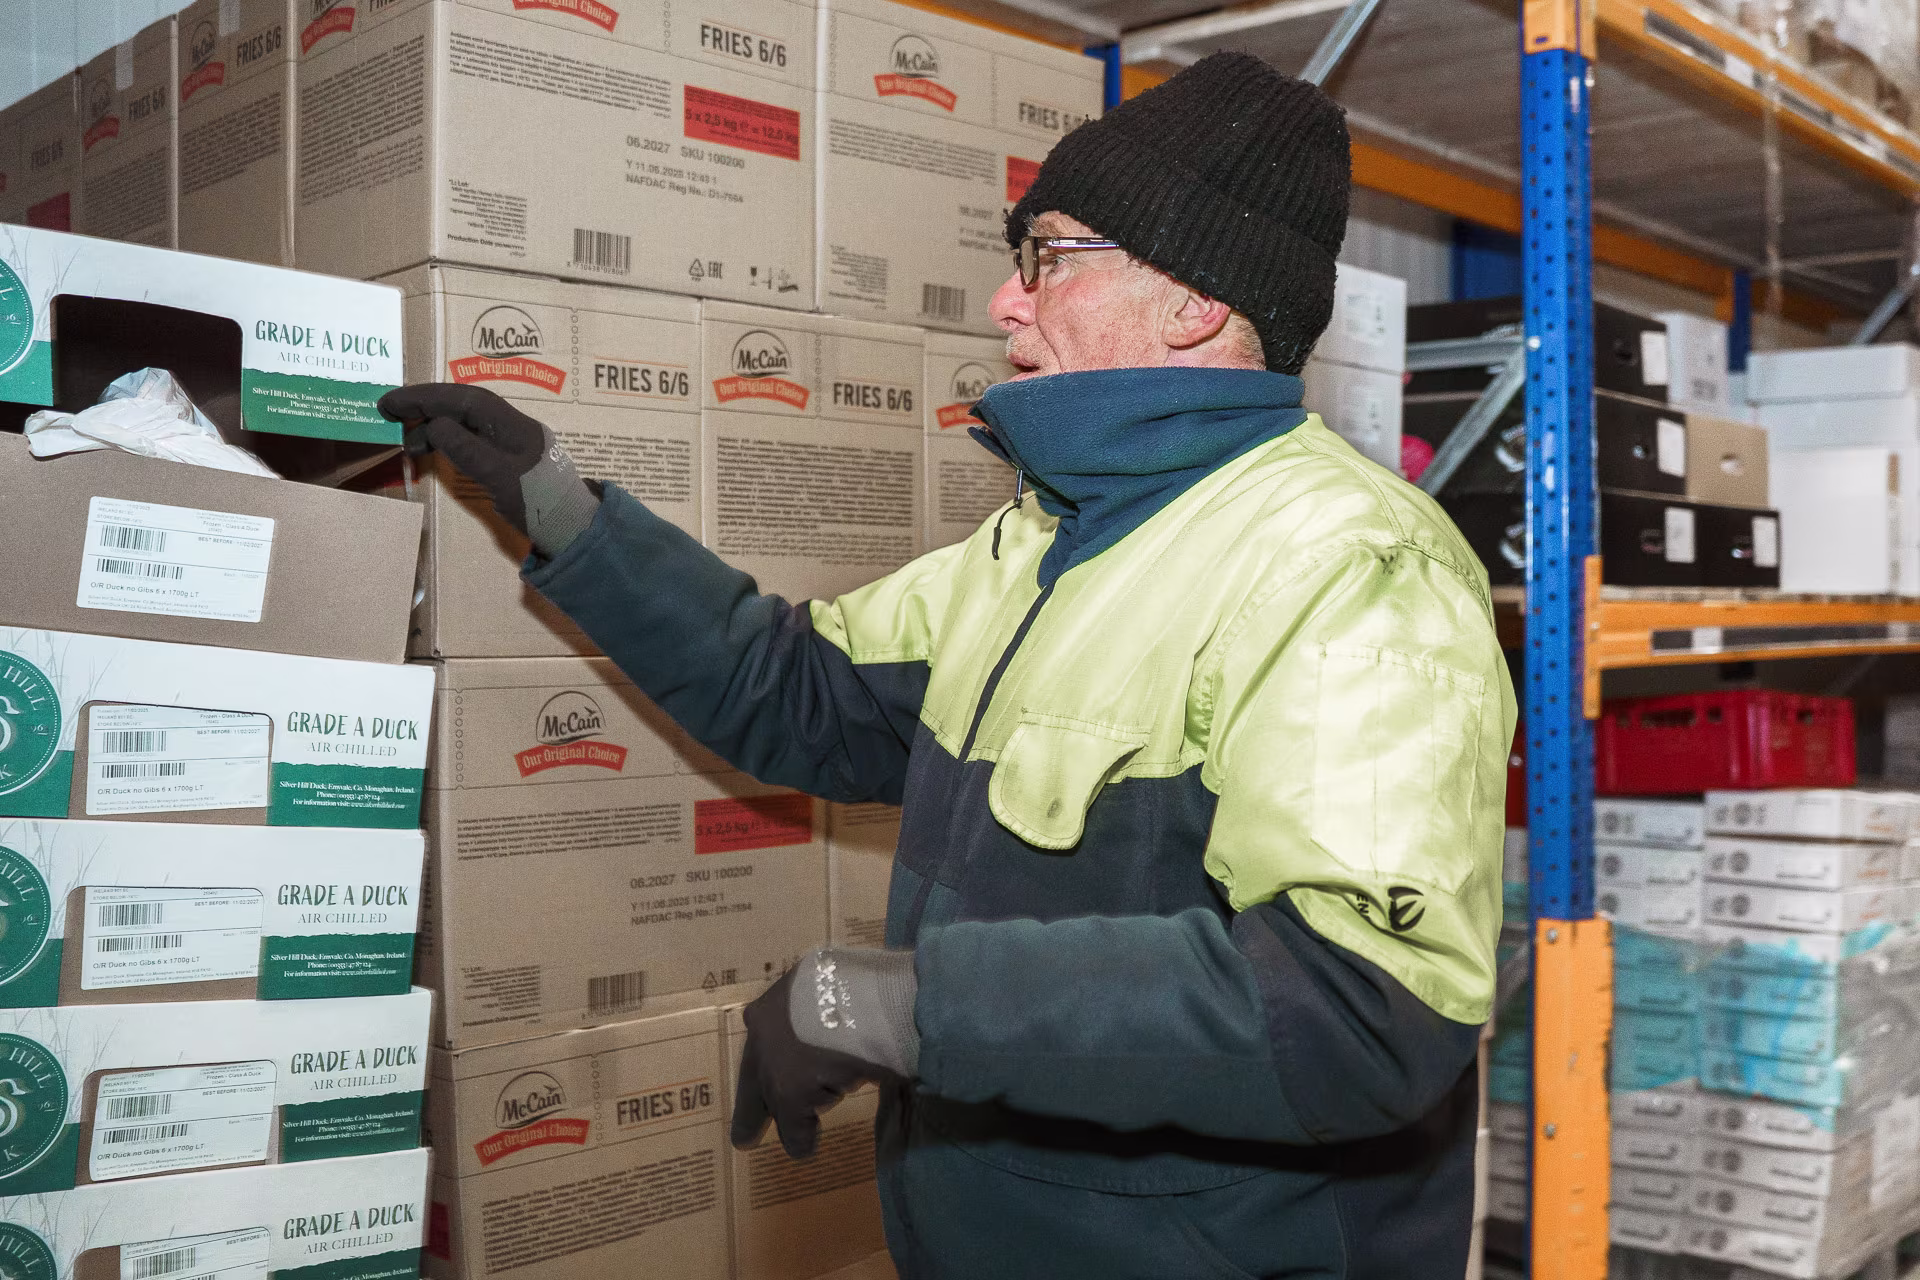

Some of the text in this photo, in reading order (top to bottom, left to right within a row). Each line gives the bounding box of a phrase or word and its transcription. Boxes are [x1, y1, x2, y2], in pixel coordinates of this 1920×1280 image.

[580, 0, 612, 25] Choice
[236, 33, 265, 68] FRIES
[265, 25, 282, 55] 6/6
[700, 24, 787, 68] FRIES 6/6
[894, 51, 938, 73] McCain
[685, 108, 693, 120] 5
[1018, 101, 1060, 131] FRIES
[626, 135, 671, 154] 06.2027
[681, 145, 705, 161] SKU
[626, 159, 633, 169] Y
[625, 173, 666, 190] NAFDAC
[668, 180, 687, 196] Reg
[255, 319, 390, 358] GRADE A DUCK
[478, 326, 540, 351] McCain
[277, 351, 371, 373] AIR CHILLED
[737, 349, 788, 371] McCain
[457, 360, 559, 387] Our Original Choice
[594, 363, 690, 397] FRIES 6/6
[252, 386, 270, 397] Silver
[270, 388, 282, 398] Hill
[719, 379, 805, 401] Our Original Choice
[833, 382, 913, 412] FRIES 6/6
[267, 405, 278, 414] For
[278, 406, 312, 418] information
[312, 410, 326, 419] visit:
[290, 400, 311, 410] Phone:
[90, 581, 104, 590] O/R
[106, 583, 125, 592] Duck
[126, 585, 136, 593] no
[137, 584, 154, 595] Gibs
[190, 591, 200, 599] LT
[3, 665, 46, 711] HILL
[287, 710, 419, 741] GRADE A DUCK
[542, 710, 601, 739] McCain
[307, 741, 398, 757] AIR CHILLED
[522, 744, 621, 769] Our Original Choice
[112, 787, 132, 795] Duck
[143, 785, 161, 794] Gibs
[173, 784, 194, 794] 1700g
[279, 780, 297, 789] Silver
[297, 781, 309, 790] Hill
[630, 865, 753, 890] 06.2027 SKU 100200
[277, 883, 409, 907] GRADE A DUCK
[297, 912, 388, 924] AIR CHILLED
[139, 959, 156, 967] Gibs
[169, 957, 190, 966] 1700g
[8, 1047, 52, 1089] HILL
[290, 1045, 418, 1075] GRADE A DUCK
[310, 1073, 398, 1091] AIR CHILLED
[501, 1089, 562, 1123] McCain
[616, 1082, 711, 1126] FRIES 6/6
[482, 1122, 584, 1158] Our Original Choice
[97, 1153, 111, 1161] O/R
[112, 1151, 132, 1159] Duck
[283, 1202, 416, 1240] GRADE A DUCK
[303, 1231, 395, 1255] AIR CHILLED
